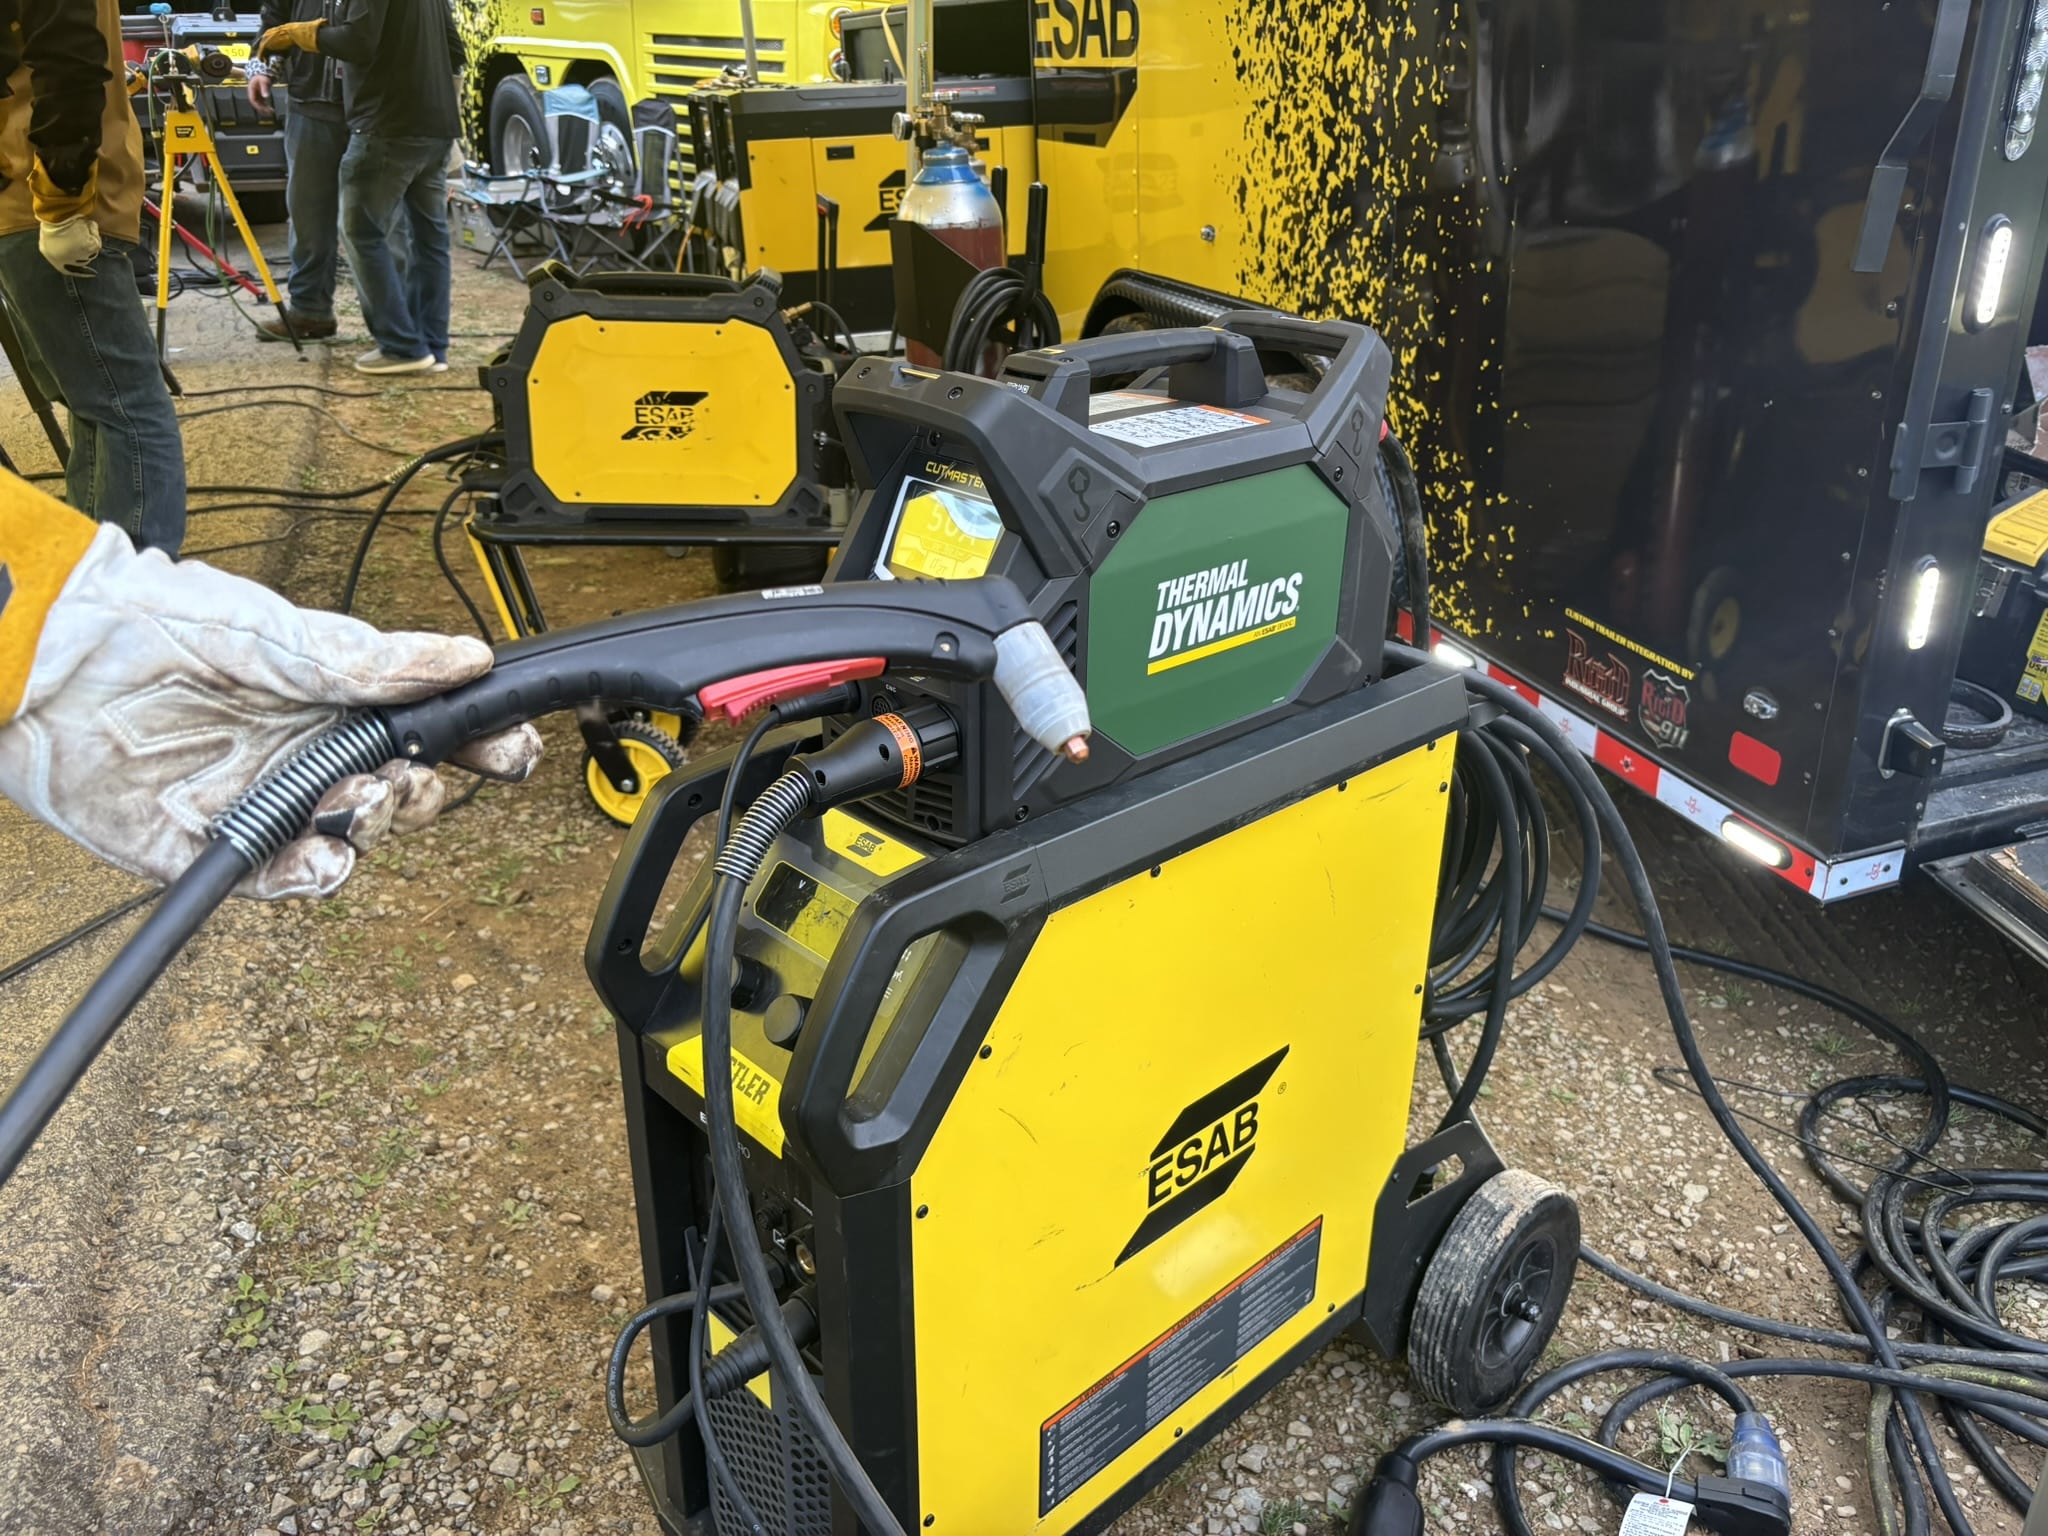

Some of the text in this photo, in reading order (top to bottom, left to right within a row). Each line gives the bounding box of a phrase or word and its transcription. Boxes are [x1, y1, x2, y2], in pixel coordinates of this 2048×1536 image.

[1033, 0, 1140, 60] ESAB
[879, 189, 906, 211] ES
[1157, 558, 1248, 611] THERMAL
[1148, 571, 1303, 659] DYNAMICS
[1565, 607, 1696, 681] CUSTOM TRAILER INTEGRATION BY
[2028, 660, 2048, 674] USA
[1659, 720, 1690, 748] 911
[856, 836, 877, 853] ESAB
[731, 1056, 771, 1105] TLER
[1148, 1101, 1259, 1209] ESAB
